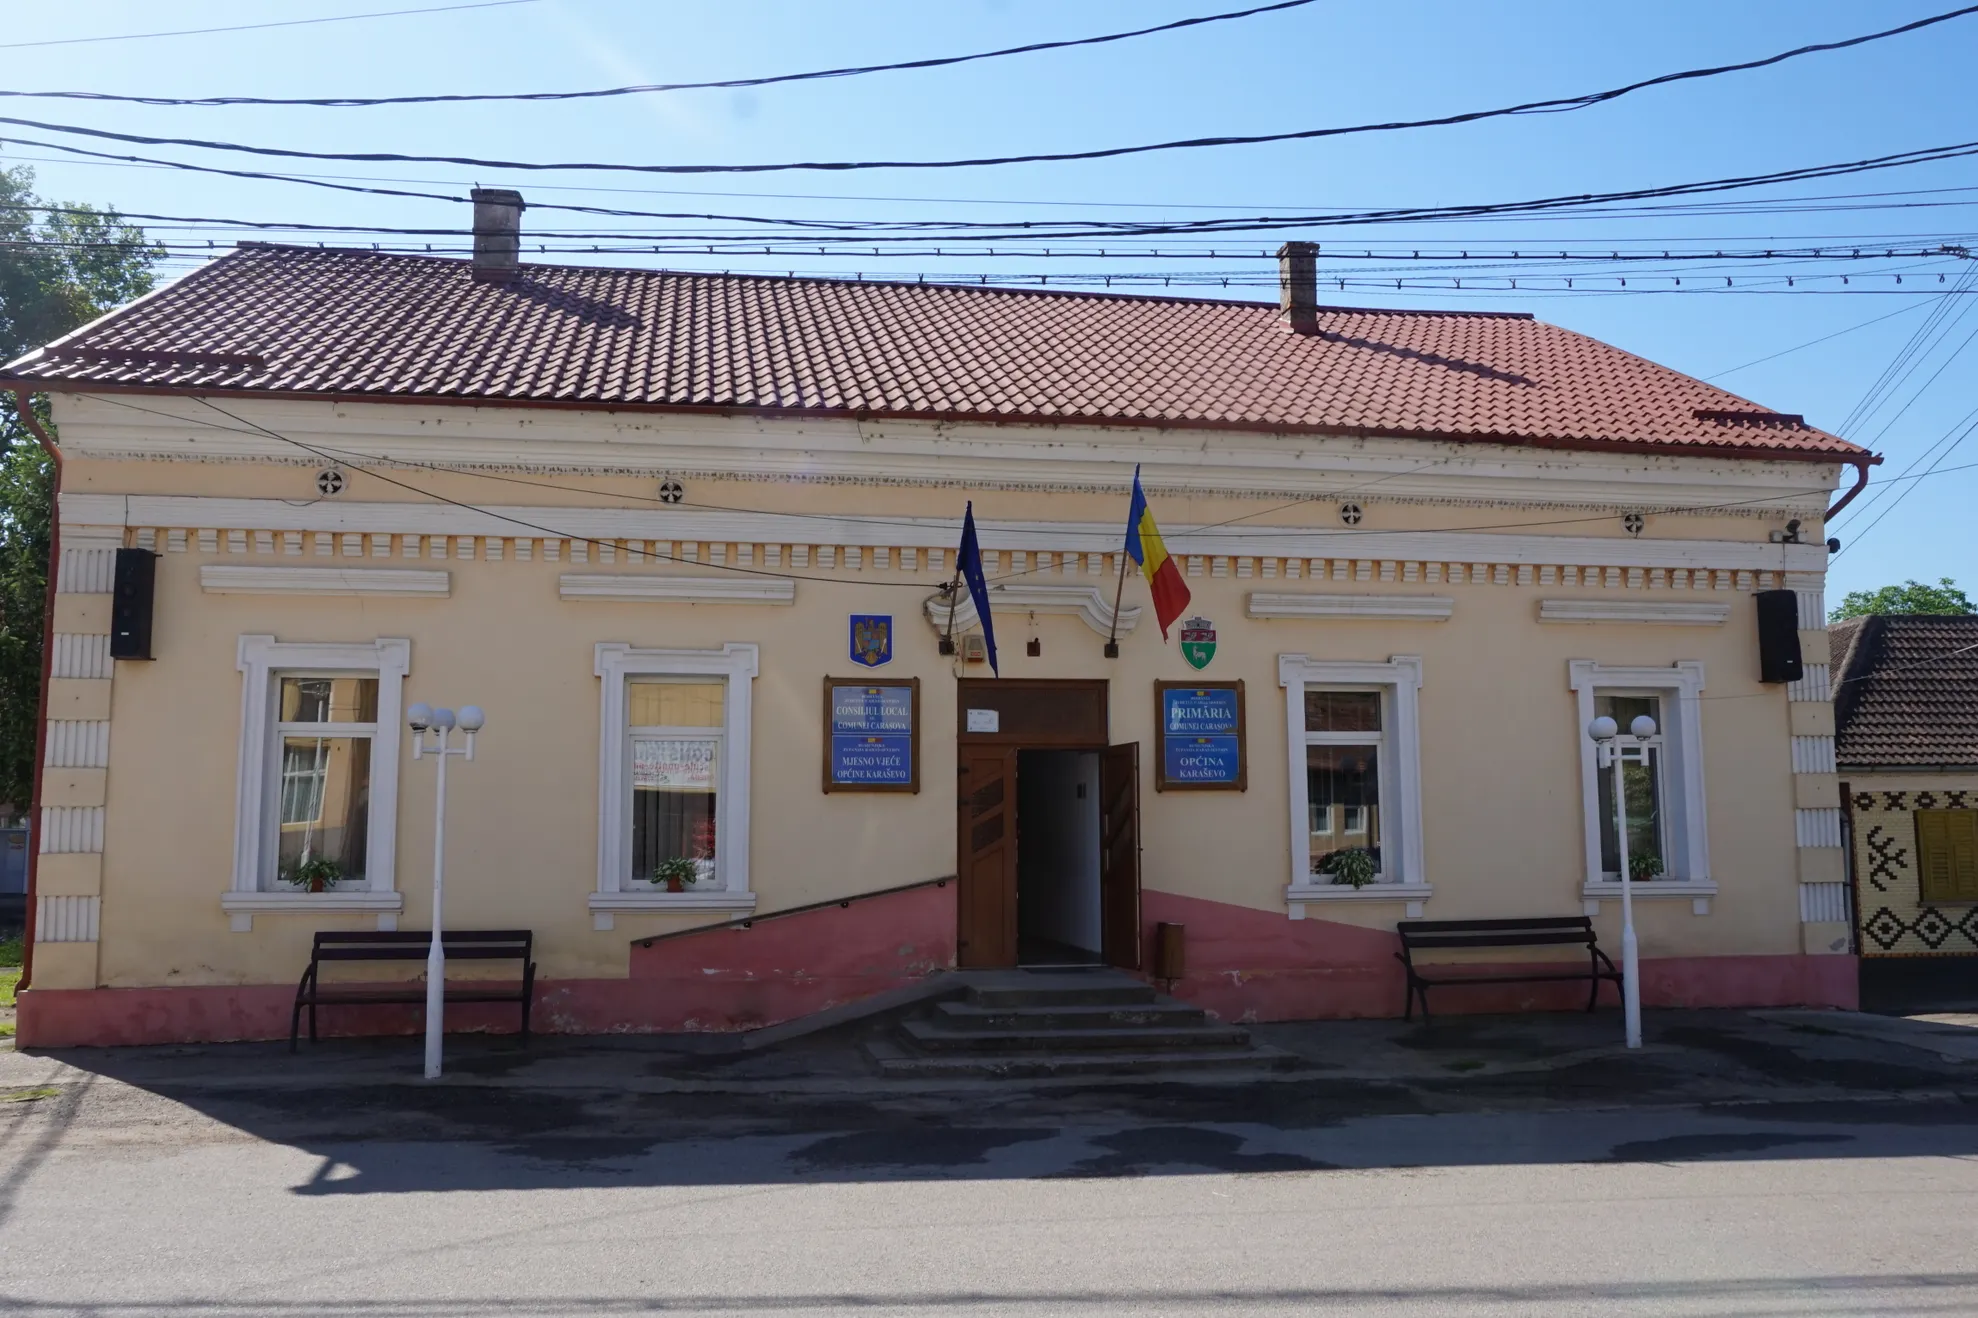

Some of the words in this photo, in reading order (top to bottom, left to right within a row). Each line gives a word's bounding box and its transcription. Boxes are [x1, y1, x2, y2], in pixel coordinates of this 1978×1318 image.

[836, 706, 879, 715] CONSILIUL
[880, 706, 908, 716] LOCAL
[1171, 705, 1231, 718] PRIMĂRIA
[837, 721, 869, 729] COMUNEI
[1169, 722, 1199, 730] COMUNEI
[842, 756, 874, 766] MJESNO
[876, 755, 901, 766] VJEĆE
[1180, 755, 1224, 766] OPĆINA
[837, 767, 865, 778] OPĆINE
[866, 767, 906, 778] KARAŠEVO
[1180, 767, 1226, 778] KARAŠEVO
